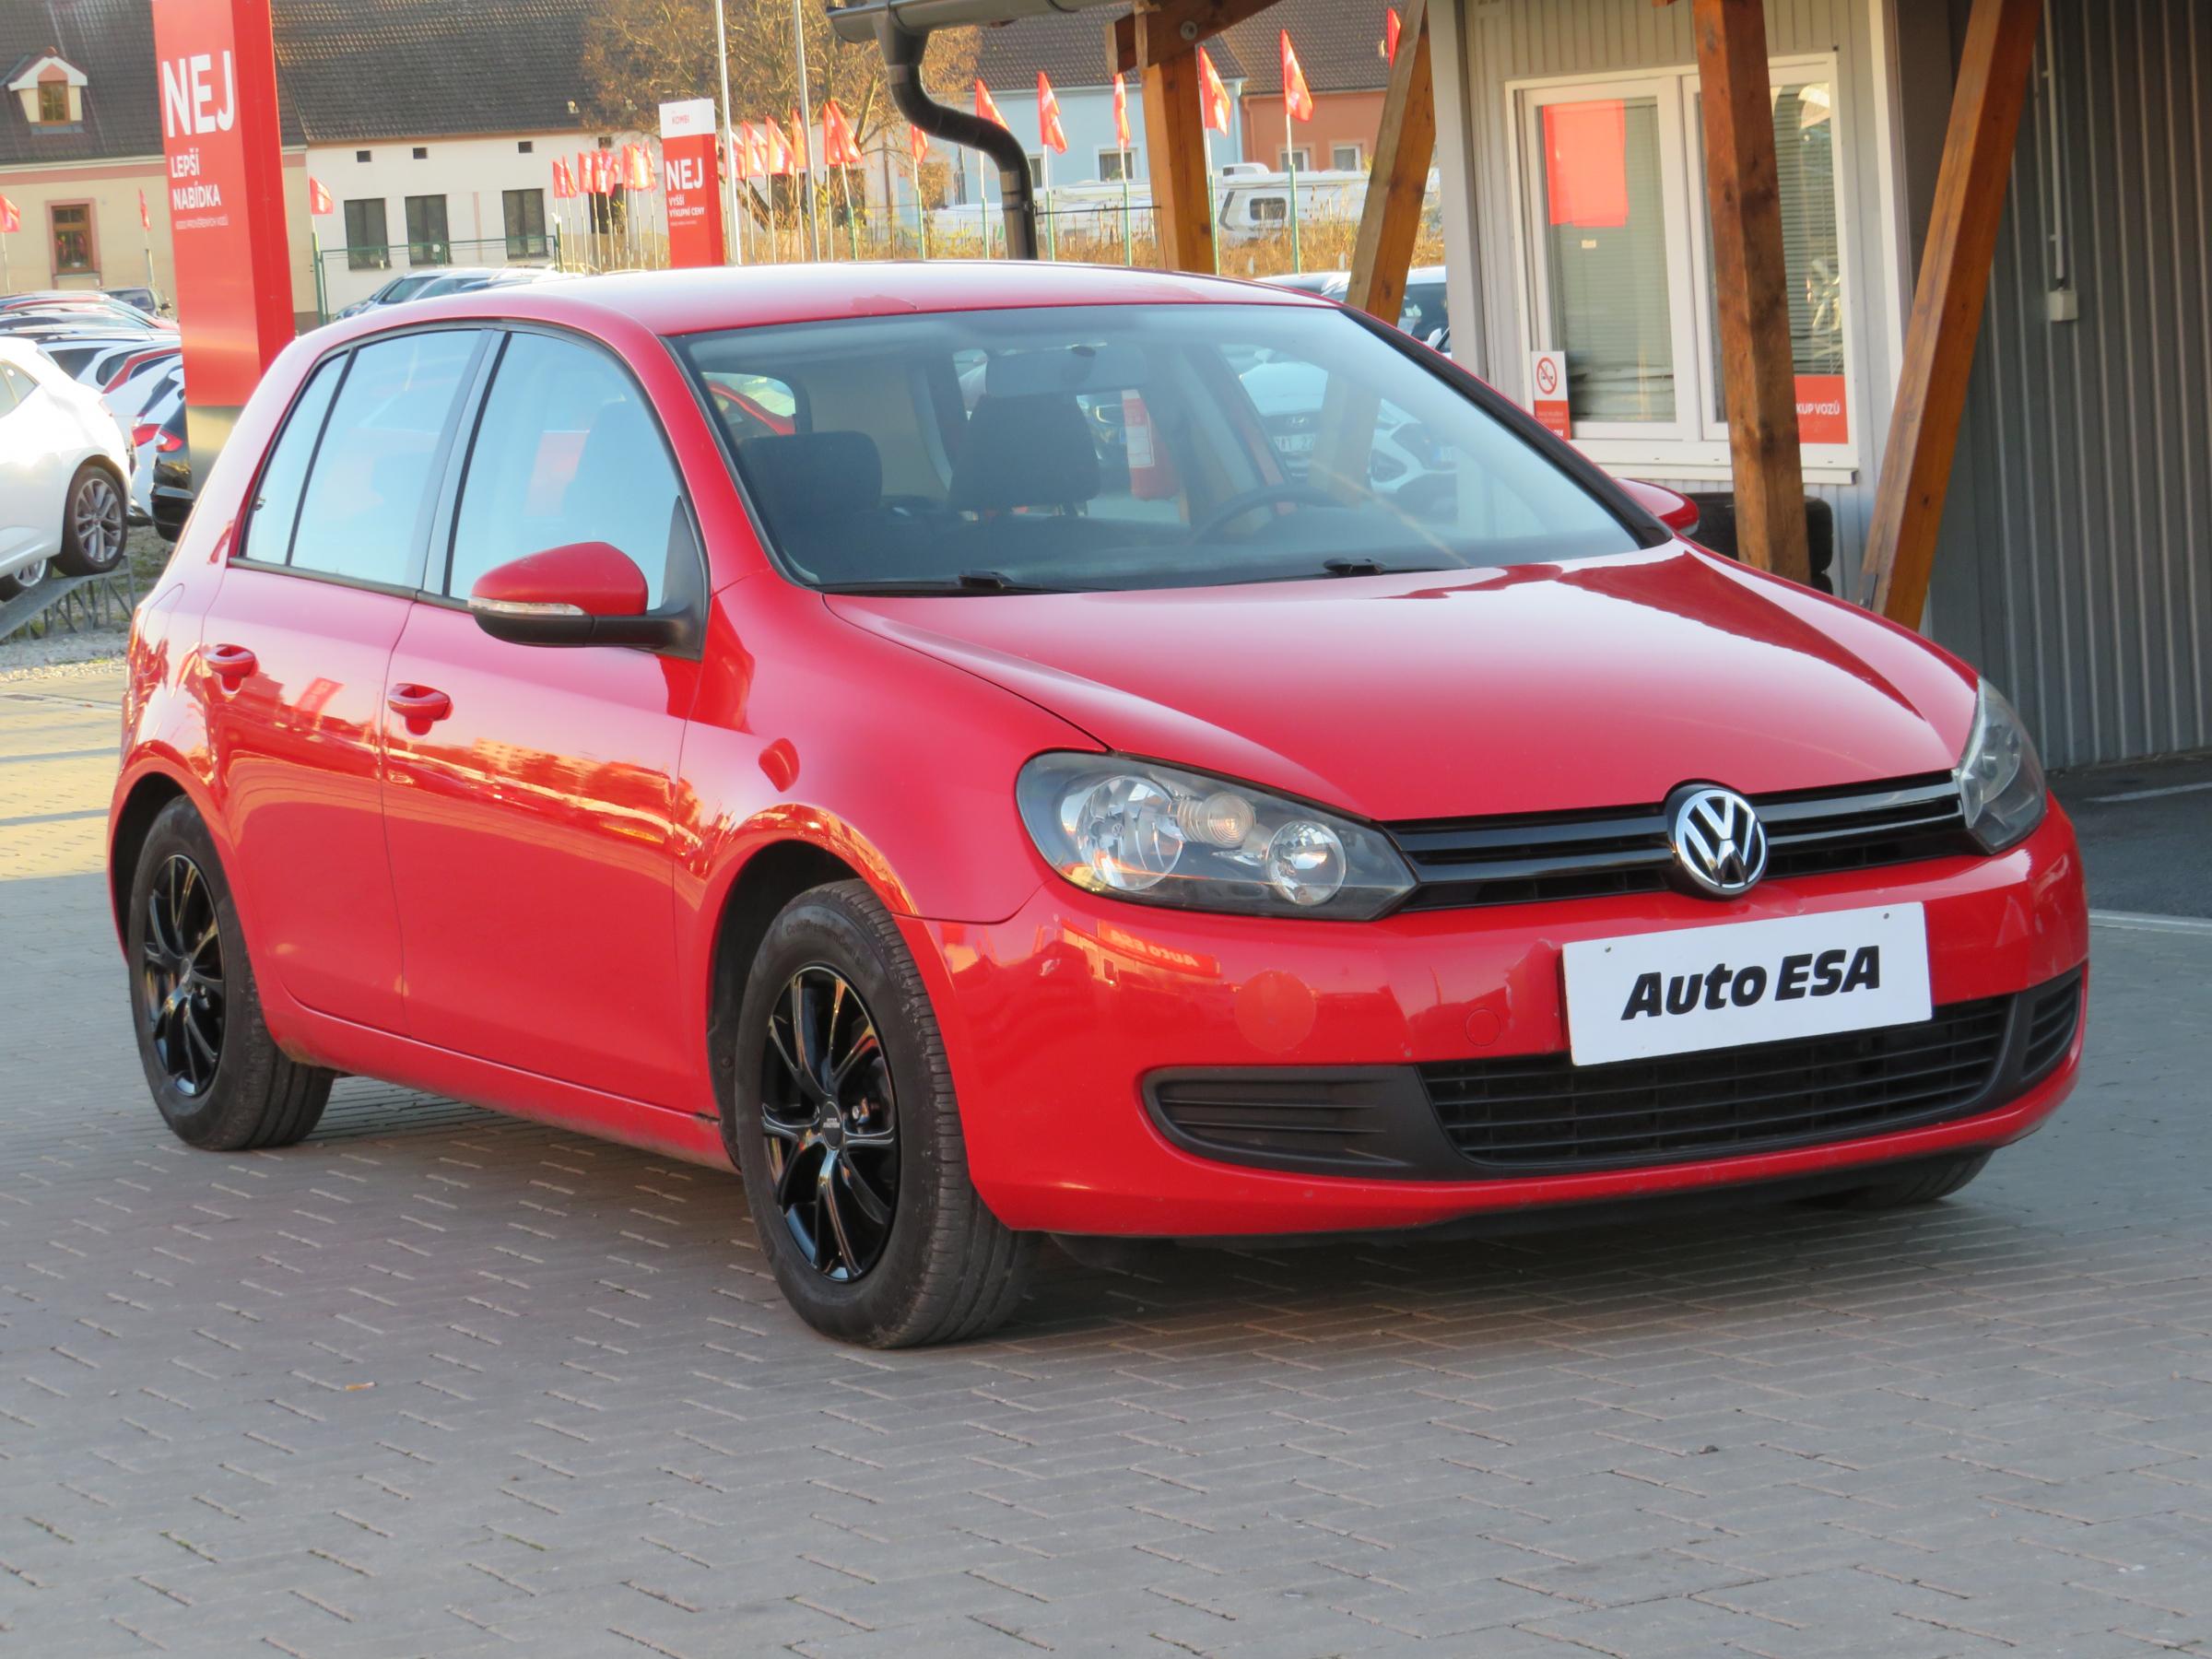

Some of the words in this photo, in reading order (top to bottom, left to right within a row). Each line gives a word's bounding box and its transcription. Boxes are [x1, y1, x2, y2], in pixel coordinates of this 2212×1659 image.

[162, 51, 235, 138] NEJ
[171, 147, 200, 179] LEPŠÍ
[665, 158, 703, 192] NEJ
[172, 181, 222, 211] NABÍDKA
[1796, 403, 1814, 415] KUP
[1619, 962, 1768, 1021] Auto
[1773, 945, 1880, 1002] ESA
